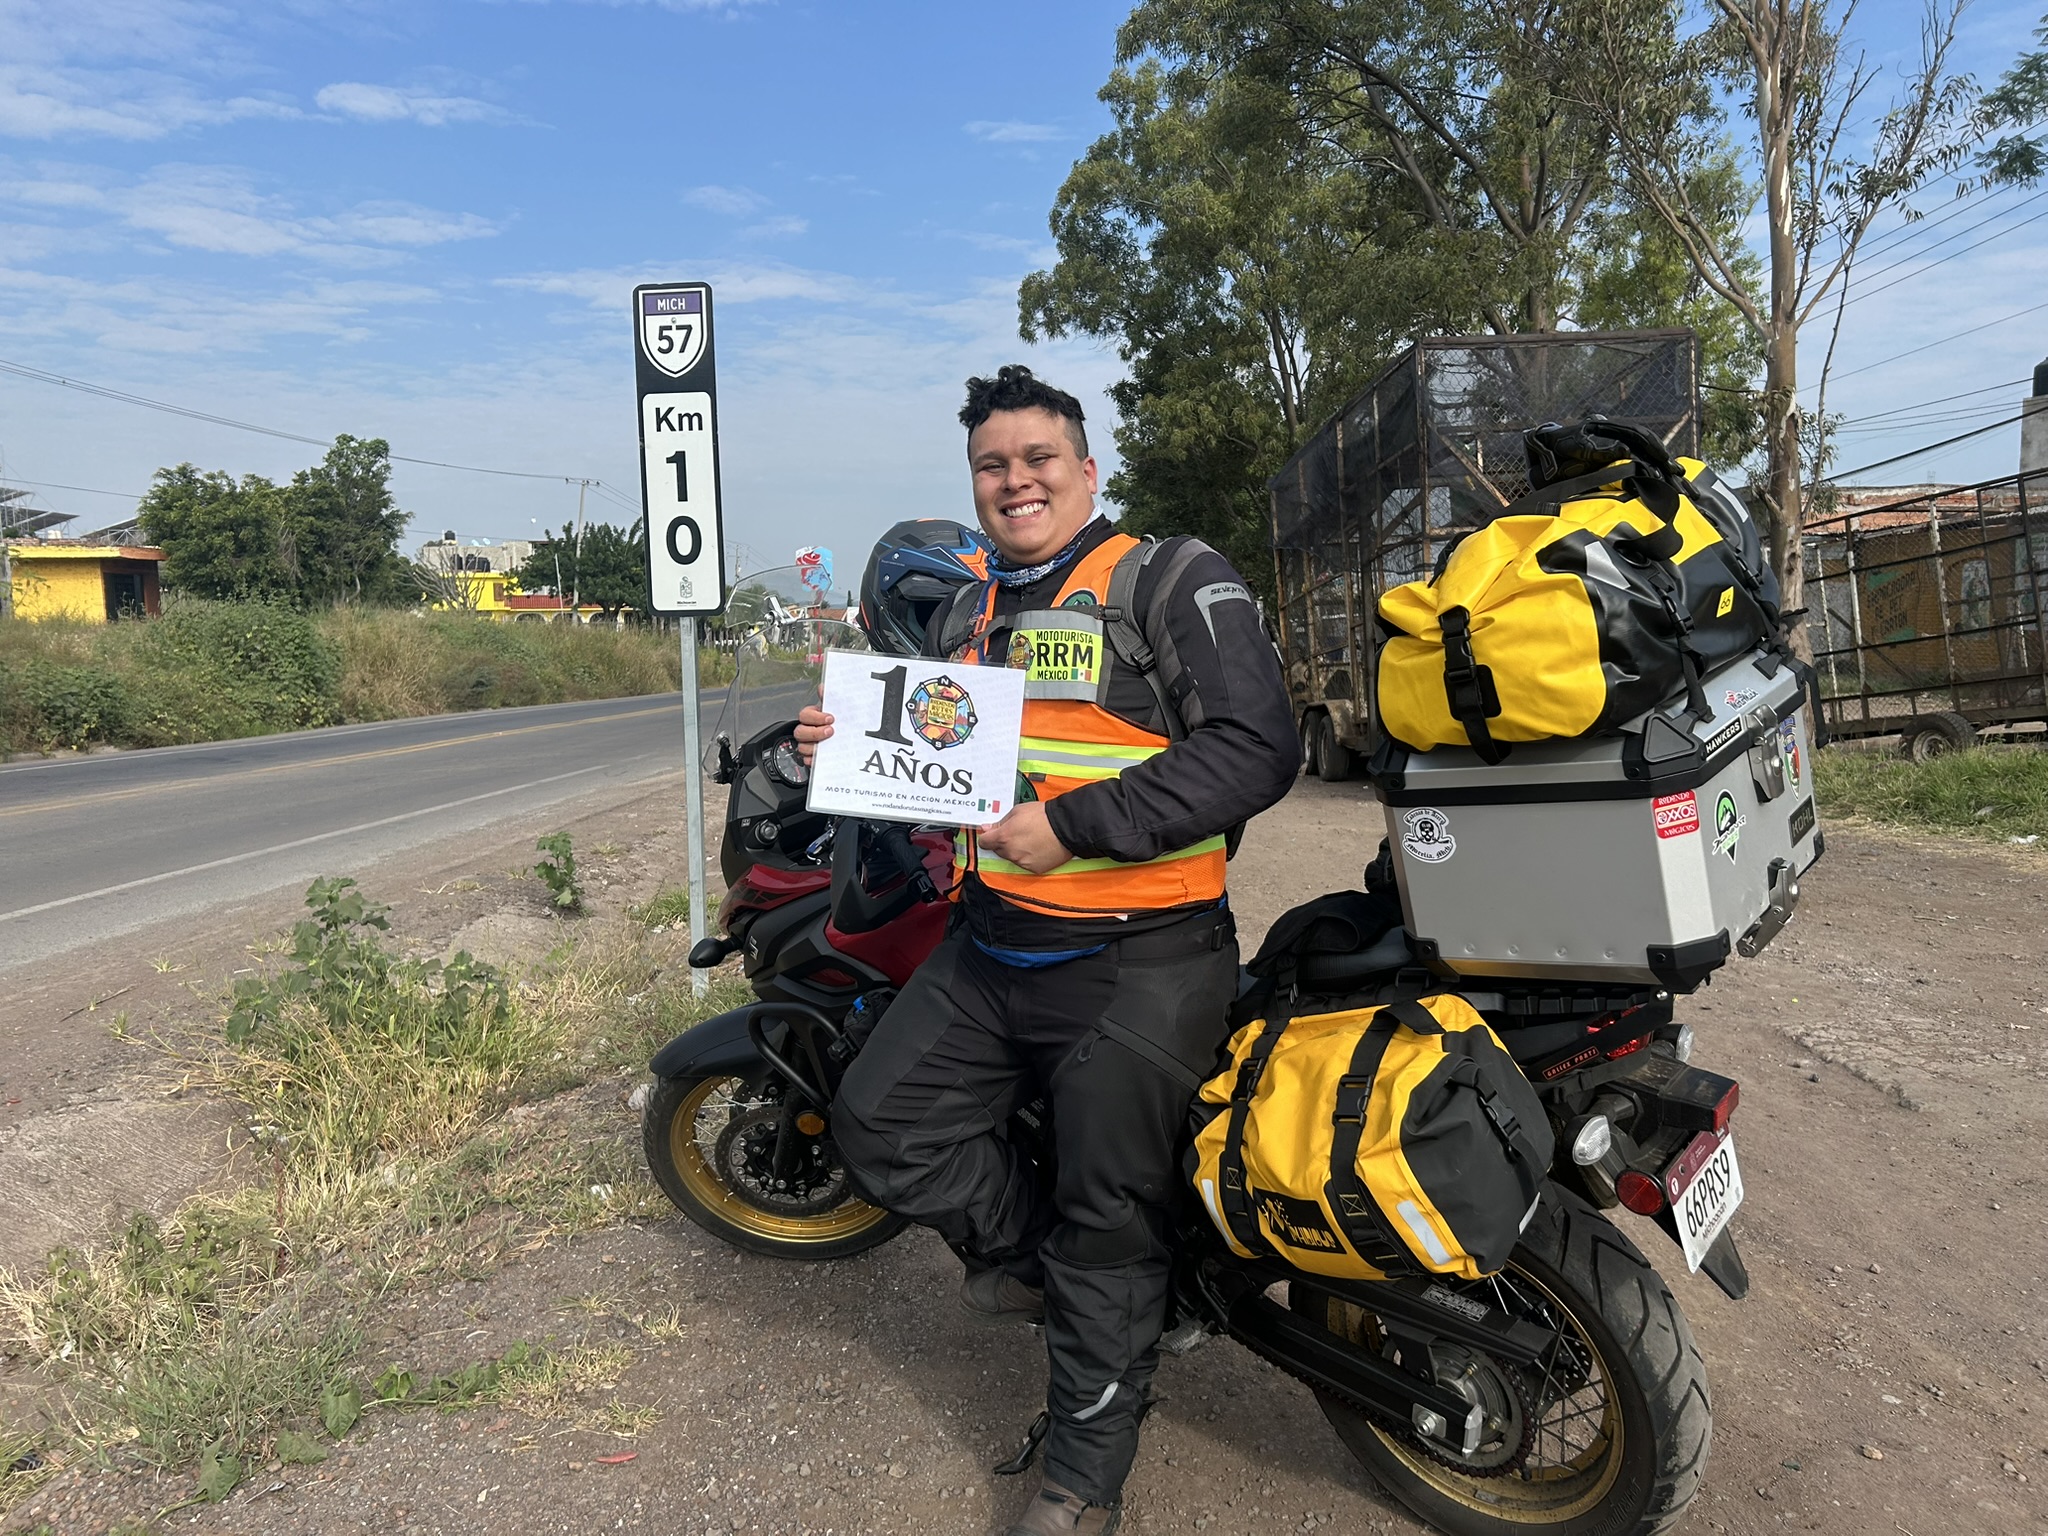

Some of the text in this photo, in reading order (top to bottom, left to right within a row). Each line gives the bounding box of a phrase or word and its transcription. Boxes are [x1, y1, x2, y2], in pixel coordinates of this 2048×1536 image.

[657, 297, 686, 311] MICH
[657, 324, 693, 355] 57
[655, 406, 704, 432] Km
[1036, 630, 1094, 645] MOTOTURISTA
[1036, 642, 1093, 669] RRM
[1037, 669, 1068, 681] MÉXICO
[1705, 721, 1741, 754] HAWKERS
[859, 747, 974, 796] AÑOS
[825, 786, 851, 794] MOTO
[854, 789, 893, 799] TURISMO
[1685, 1148, 1731, 1238] 66PRS9
